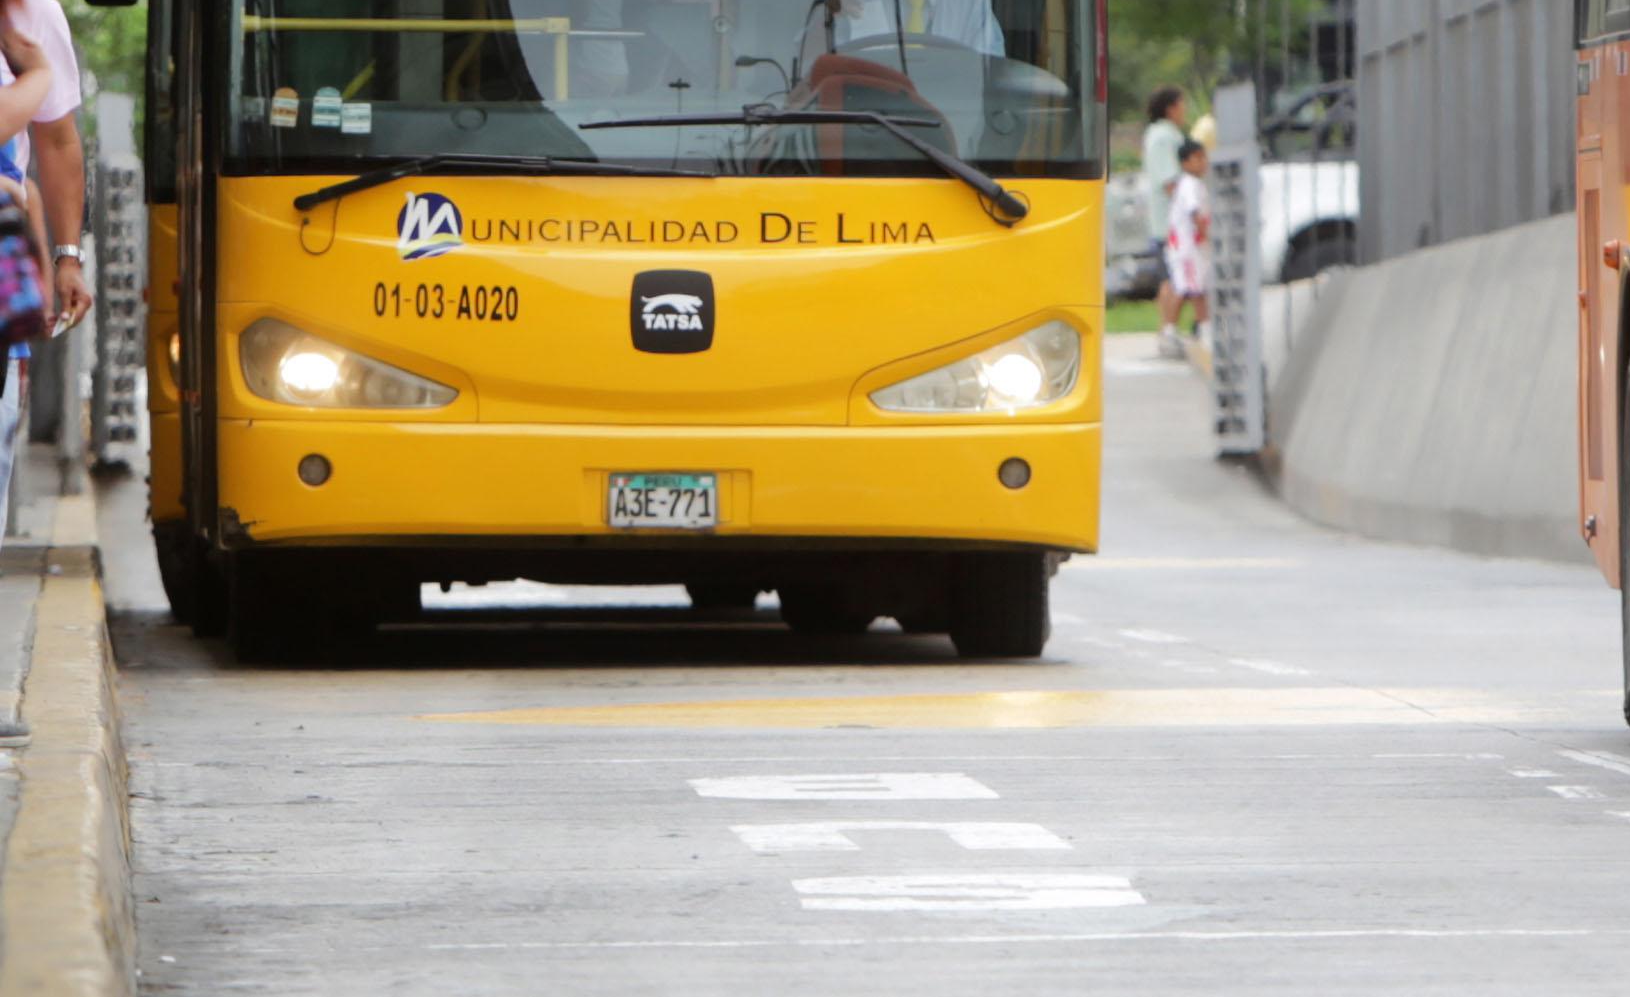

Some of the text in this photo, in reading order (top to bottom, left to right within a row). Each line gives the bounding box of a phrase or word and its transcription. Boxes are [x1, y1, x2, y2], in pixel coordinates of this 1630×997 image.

[374, 281, 520, 322] 01-03-A020
[642, 313, 703, 331] TATSA
[614, 488, 711, 518] A3E-771
